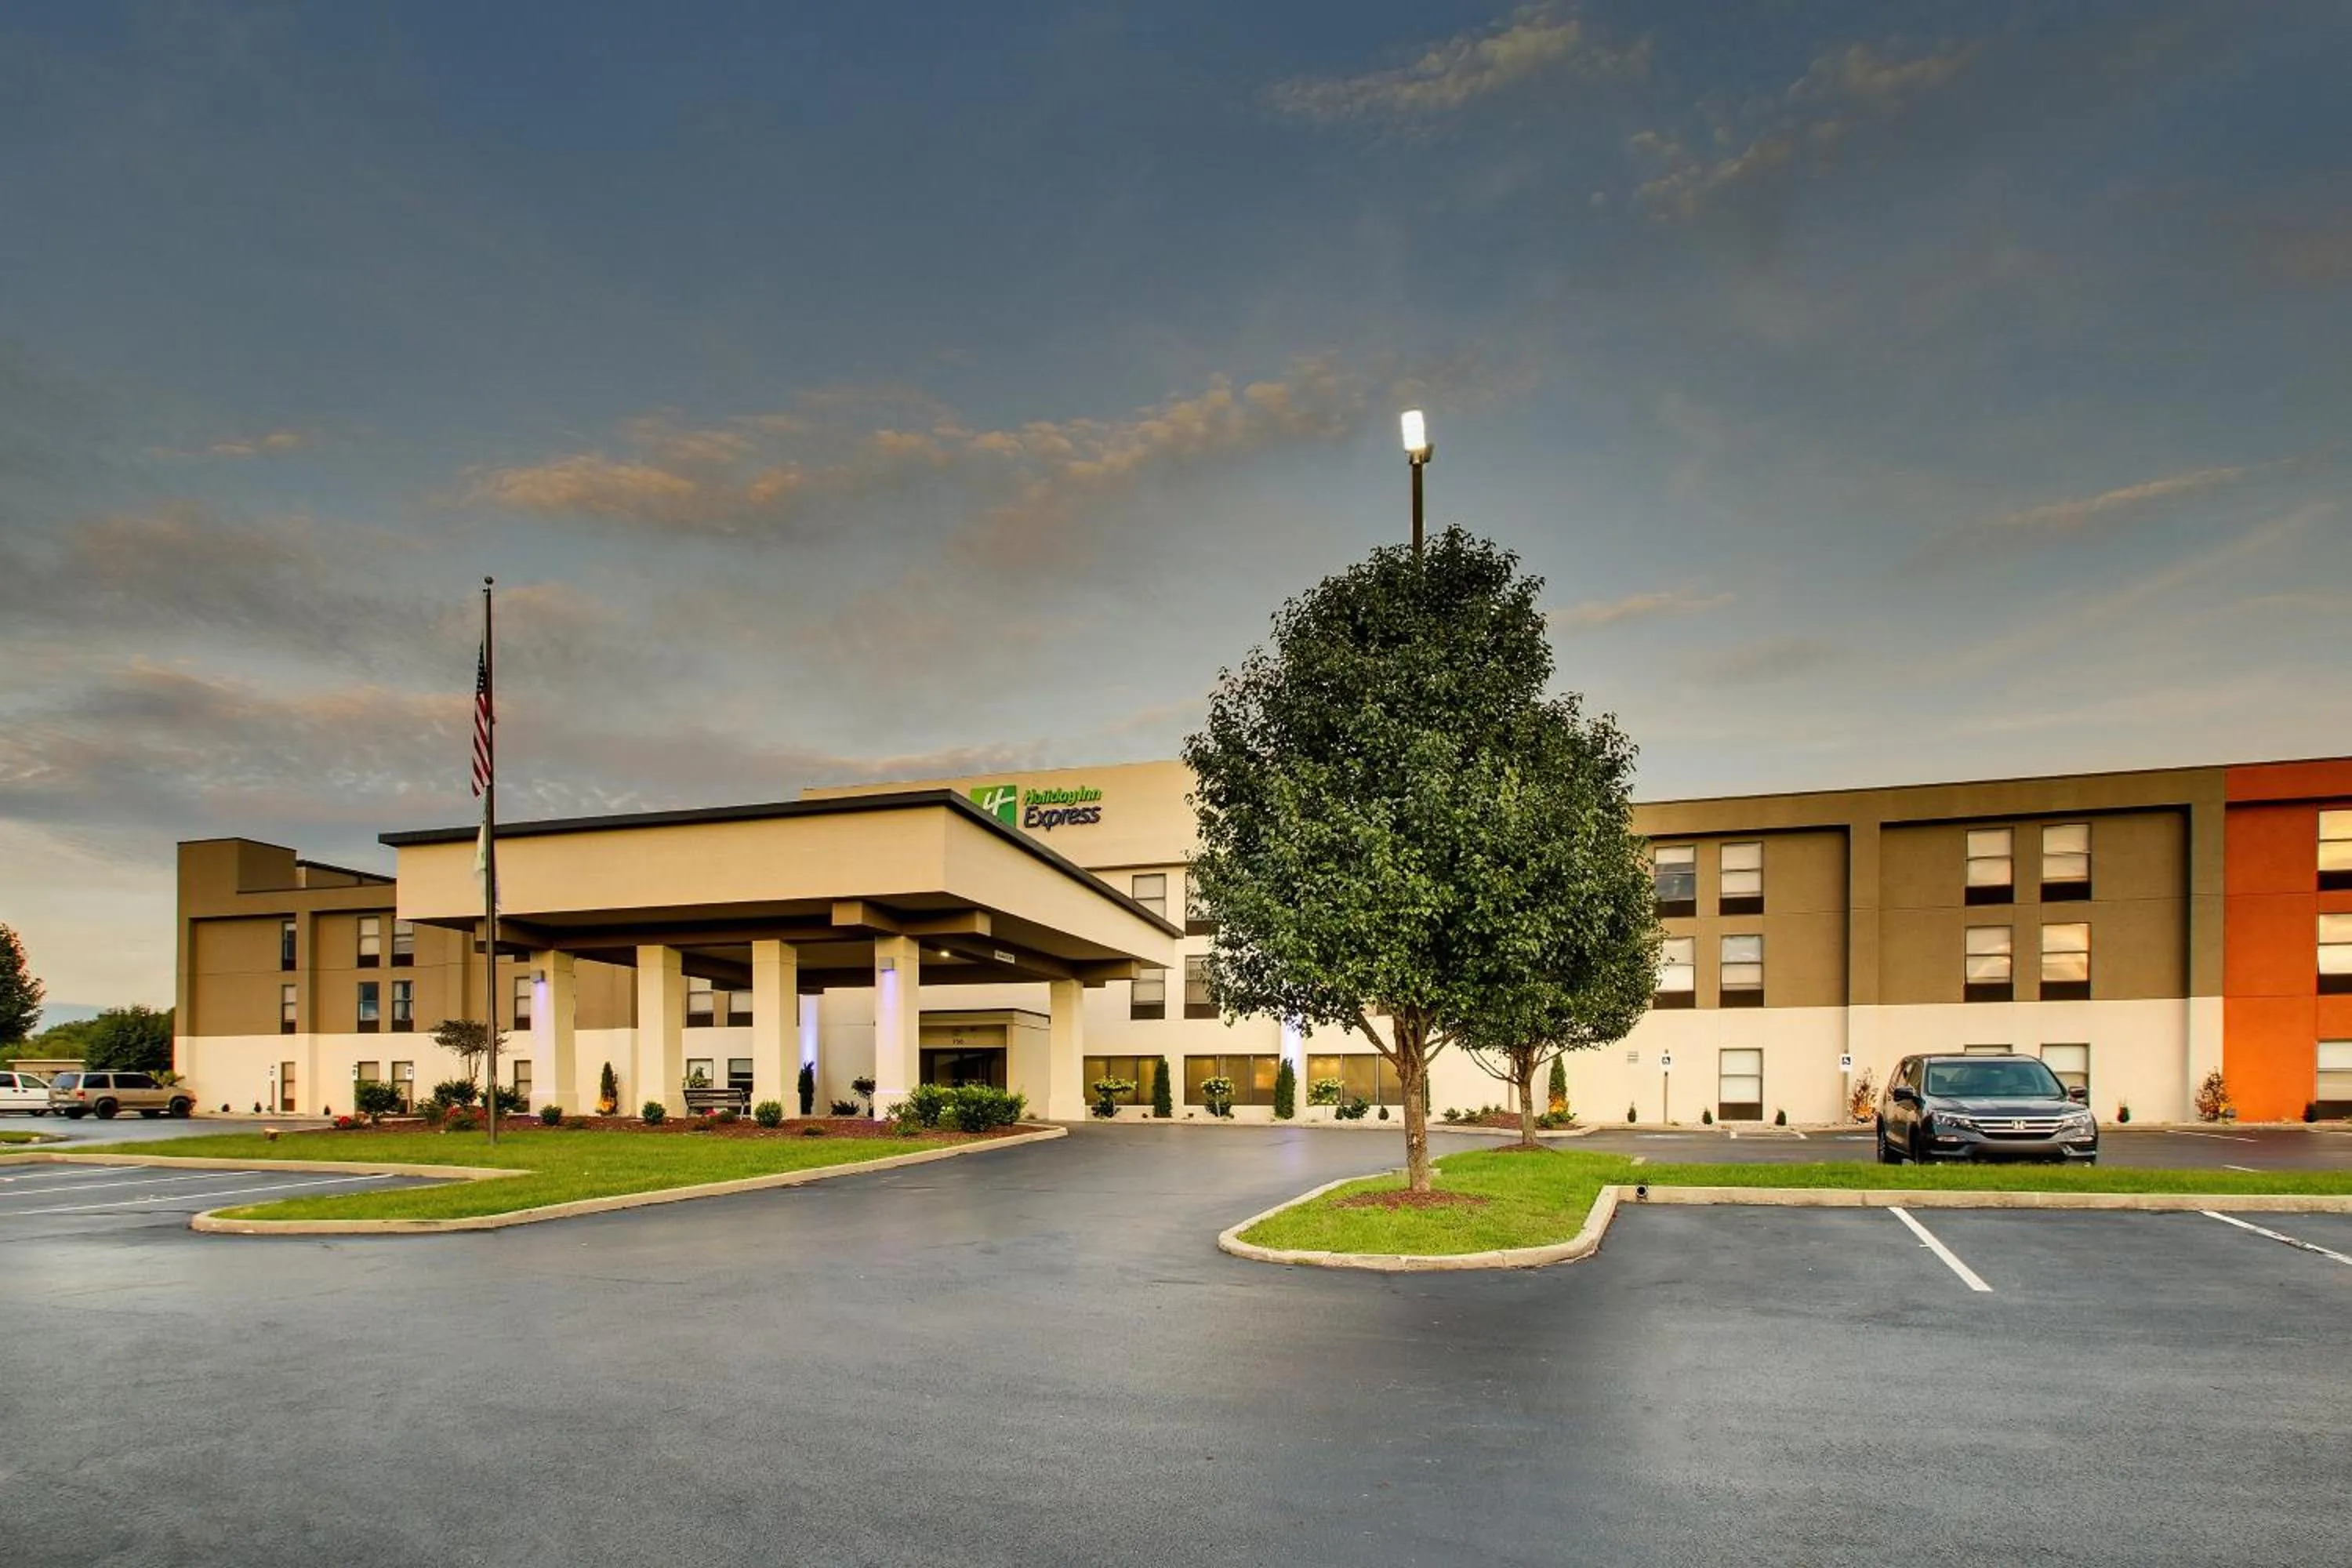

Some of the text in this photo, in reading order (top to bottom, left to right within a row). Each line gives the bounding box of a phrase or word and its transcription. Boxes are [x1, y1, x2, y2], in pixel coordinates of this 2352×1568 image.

[1024, 786, 1102, 806] Holiday Inn
[1024, 805, 1102, 830] Express
